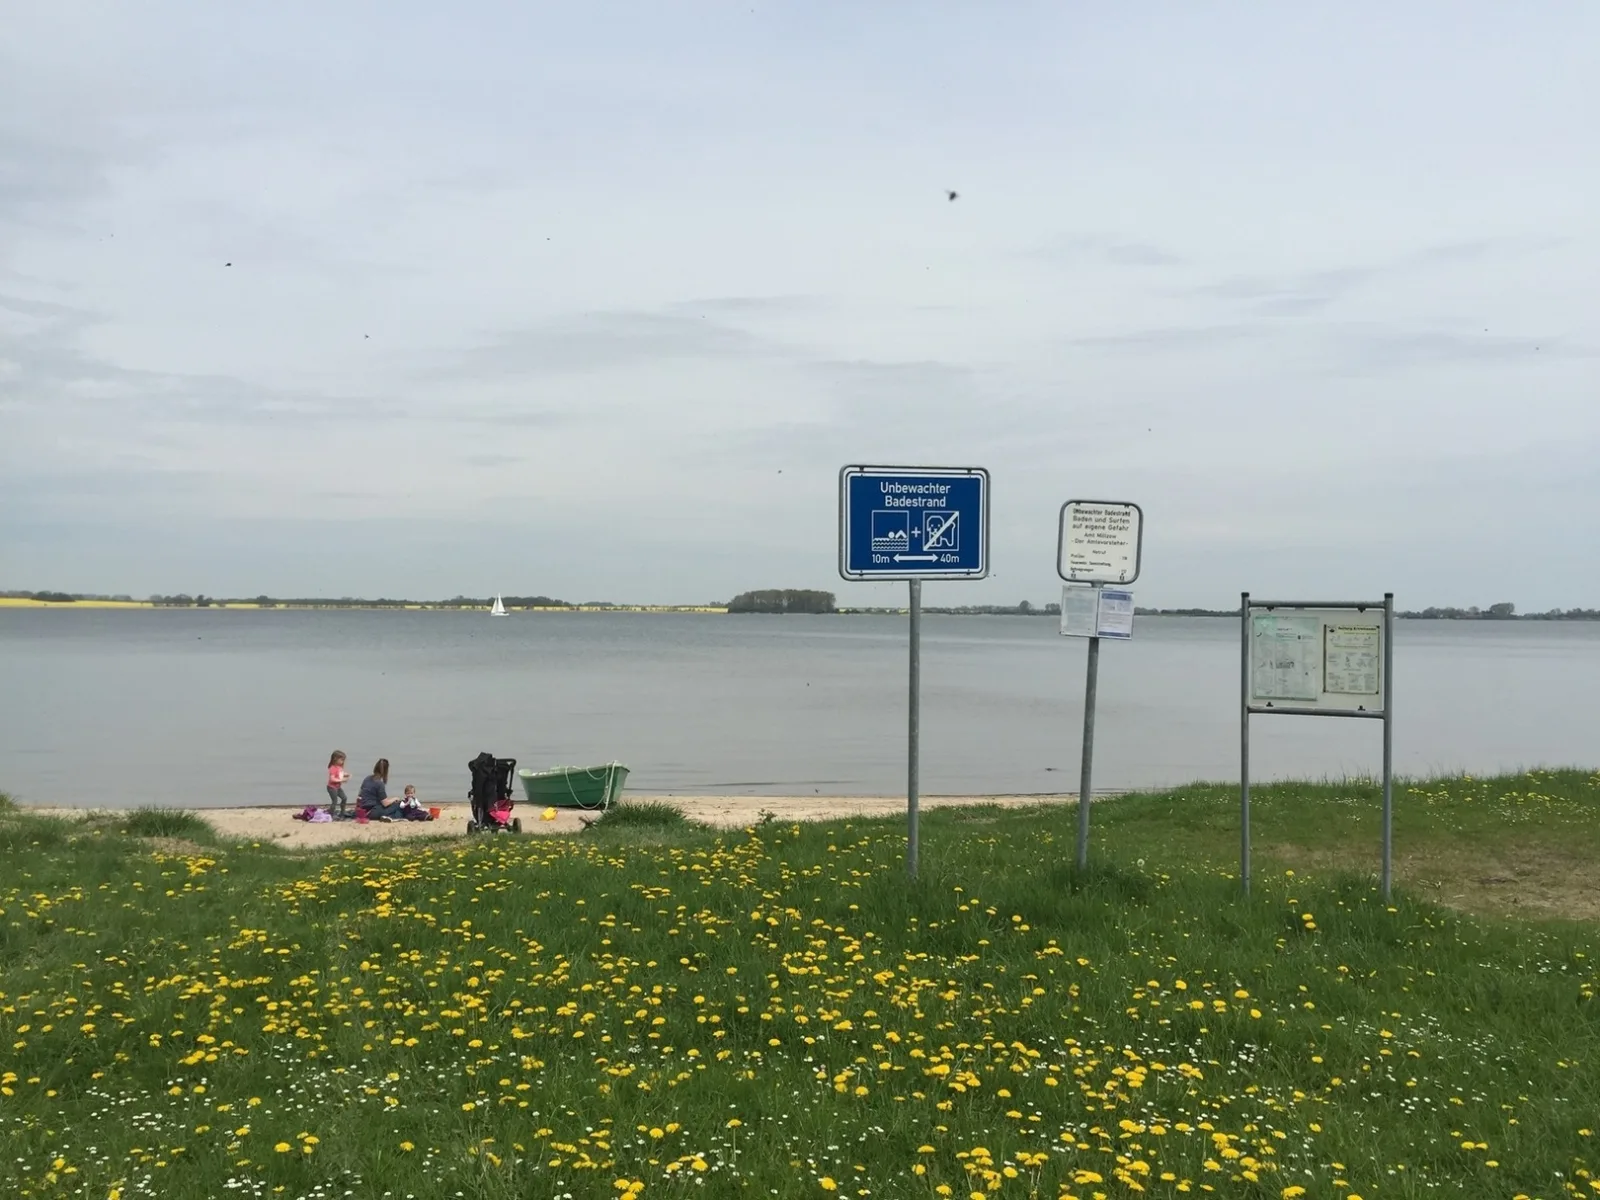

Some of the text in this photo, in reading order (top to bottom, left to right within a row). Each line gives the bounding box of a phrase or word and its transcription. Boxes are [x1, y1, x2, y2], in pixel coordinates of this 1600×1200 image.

[880, 482, 951, 493] Unbewachter
[885, 495, 946, 507] Badestrand
[872, 554, 890, 564] 10m
[940, 554, 960, 563] 40m
